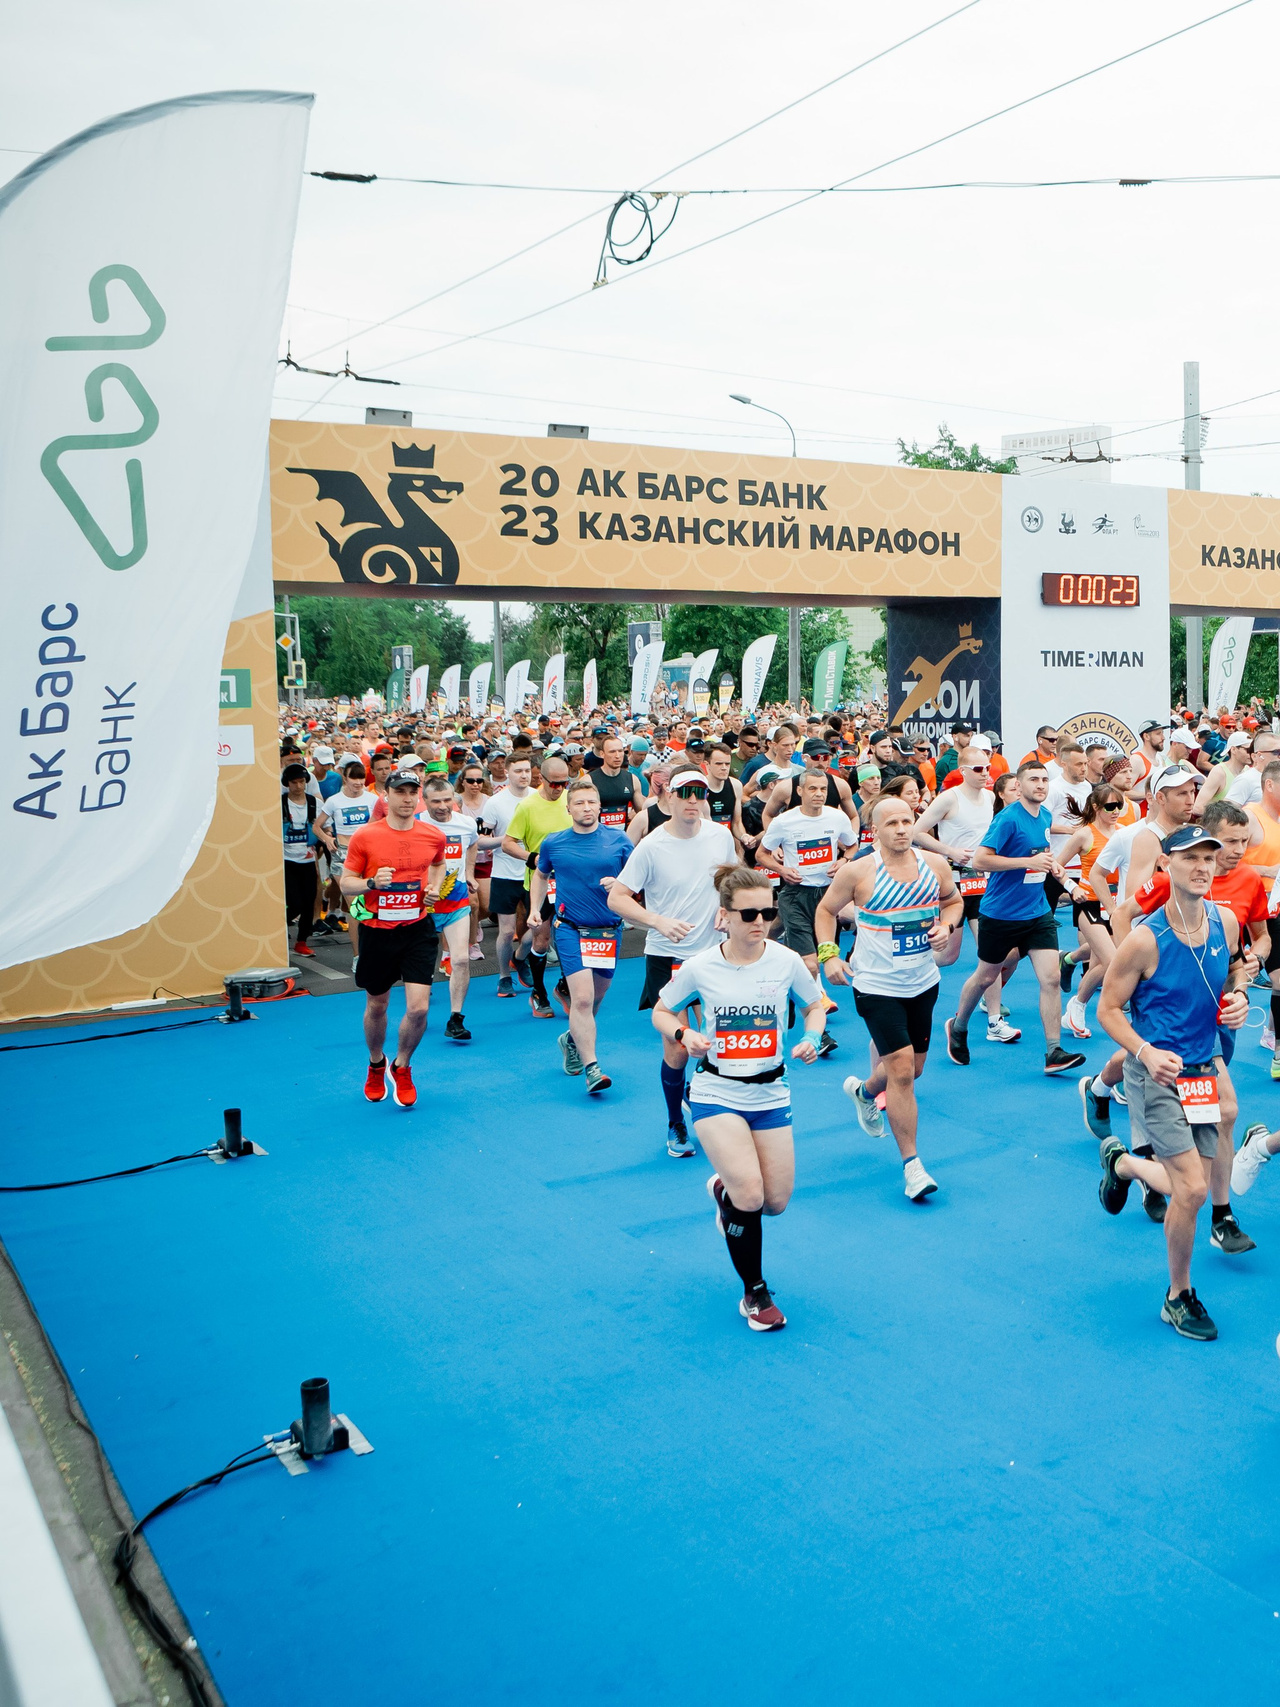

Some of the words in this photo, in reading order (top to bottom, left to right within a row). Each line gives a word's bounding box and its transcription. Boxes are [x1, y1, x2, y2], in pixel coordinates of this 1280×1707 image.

[500, 463, 560, 499] 20
[577, 468, 627, 500] АК
[637, 472, 729, 506] БАРС
[737, 479, 827, 511] БАНК
[500, 504, 560, 546] 23
[579, 510, 800, 551] КАЗАНСКИЙ
[808, 525, 962, 557] МАРАФОН
[20, 602, 86, 737] Барс
[642, 653, 651, 692] NORDSKI
[752, 656, 763, 704] DIGINAVIS
[474, 680, 483, 704] Enter
[80, 681, 137, 813] Банк
[1079, 737, 1098, 746] БАРС
[1100, 738, 1119, 754] БАНК
[14, 748, 65, 820] Ак
[350, 814, 365, 822] 809
[606, 814, 624, 822] 2889
[804, 849, 829, 860] 4037
[967, 881, 986, 890] 3860
[387, 894, 417, 904] 2792
[586, 942, 613, 952] 3207
[905, 933, 928, 948] 510
[713, 1004, 776, 1017] KIROSIN
[726, 1033, 772, 1049] 3626
[1183, 1080, 1213, 1097] 2488
